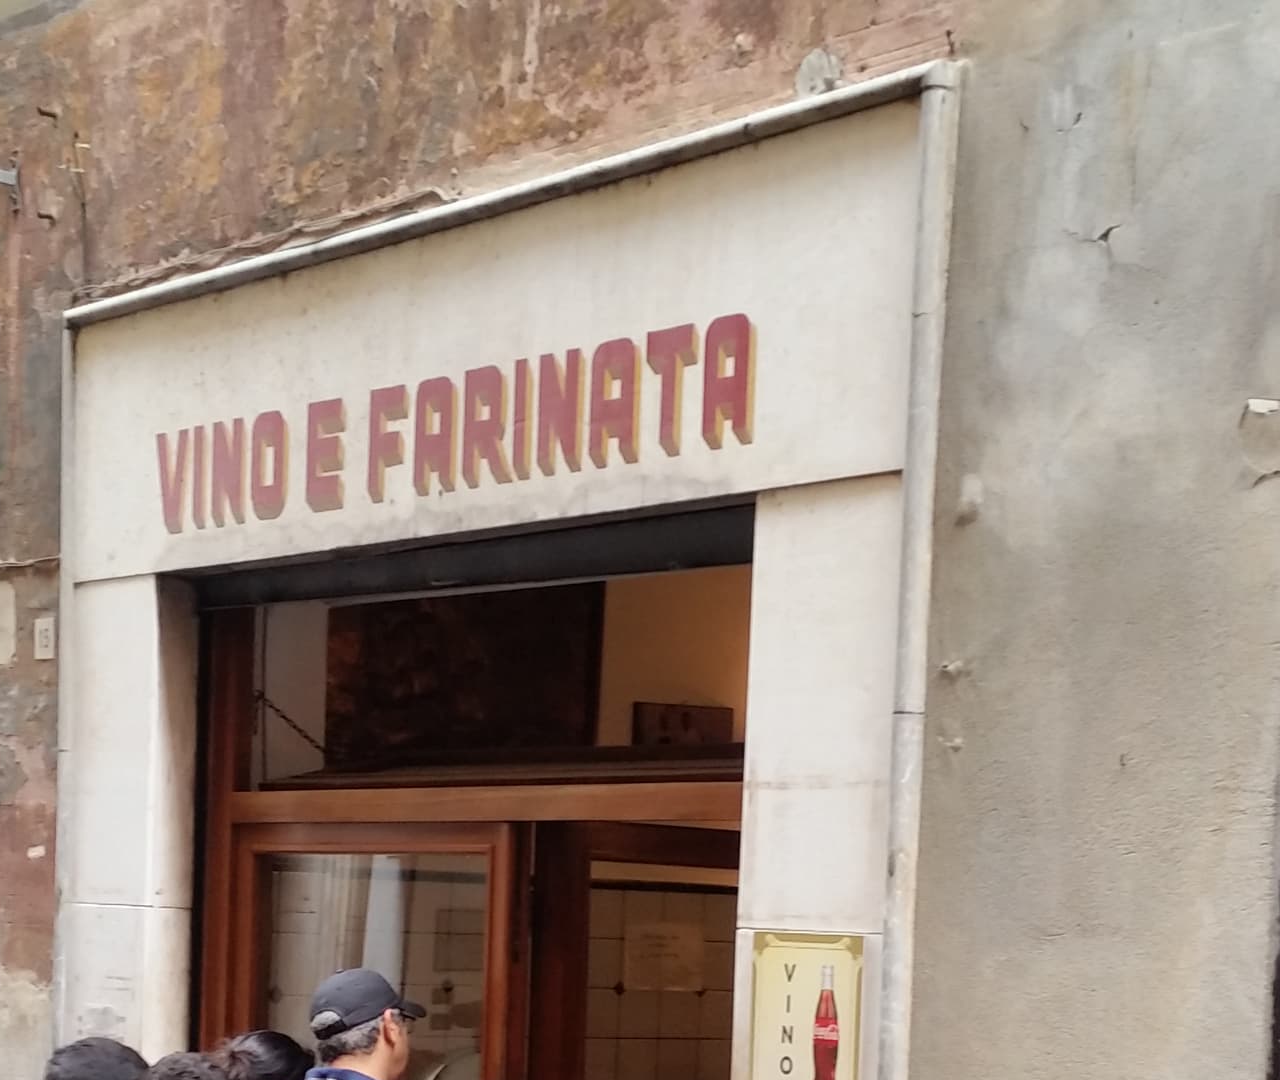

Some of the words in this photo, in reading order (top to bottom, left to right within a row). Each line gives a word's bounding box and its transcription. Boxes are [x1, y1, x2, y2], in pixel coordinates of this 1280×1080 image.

[156, 409, 289, 534] VINO
[306, 398, 348, 513] E
[367, 312, 757, 504] FARINATA
[779, 963, 797, 1075] VINO
